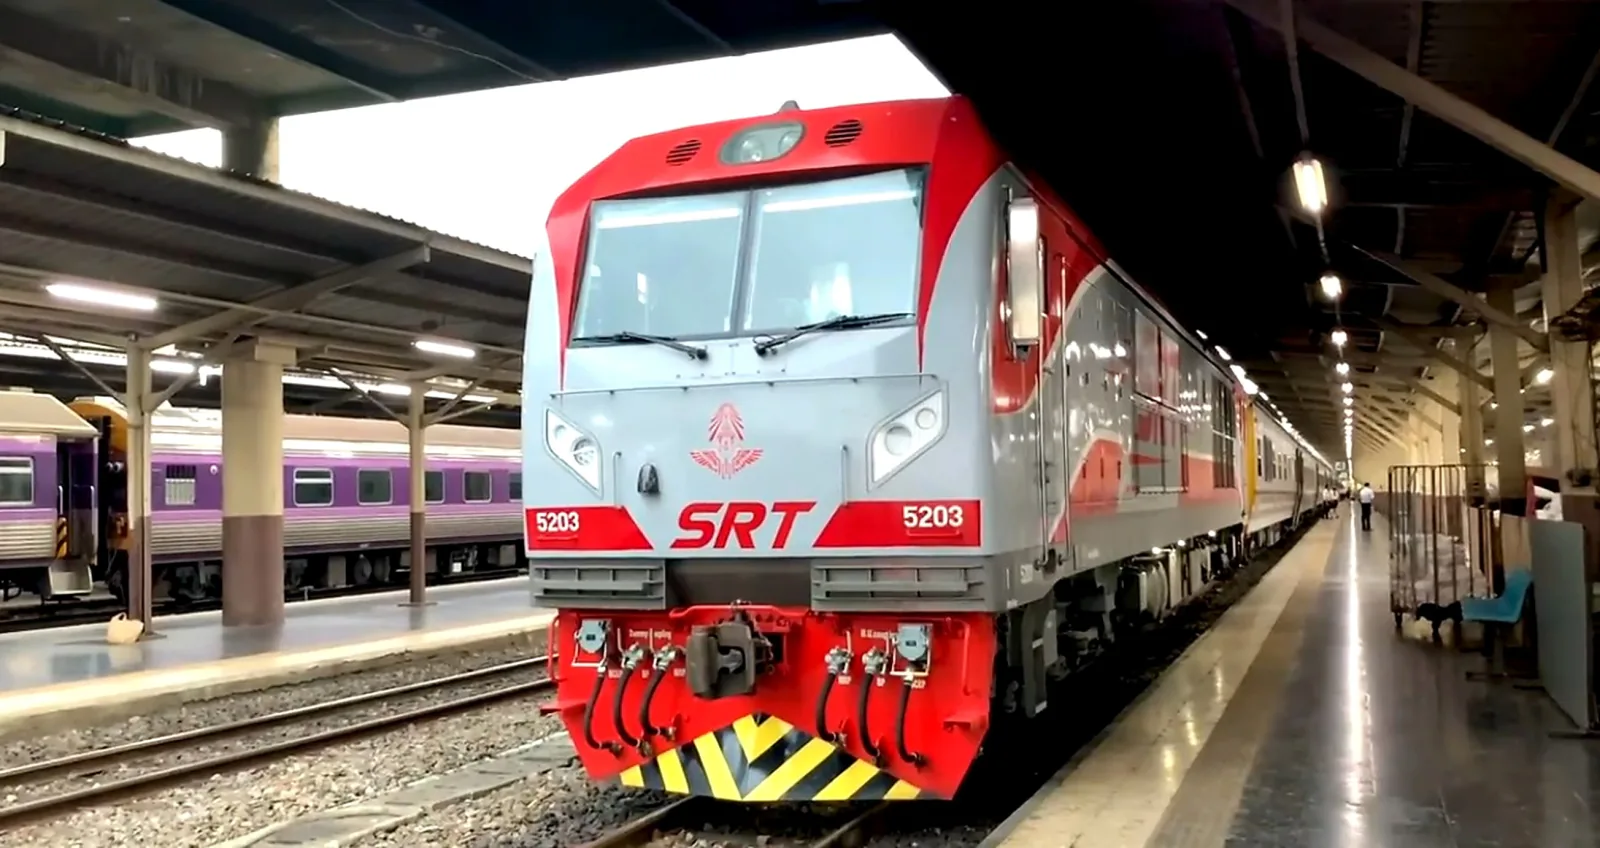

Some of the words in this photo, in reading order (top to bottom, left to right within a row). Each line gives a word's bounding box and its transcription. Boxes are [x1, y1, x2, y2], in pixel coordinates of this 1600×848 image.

[536, 511, 580, 532] 5203
[669, 500, 818, 550] SRT
[902, 504, 964, 528] 5203
